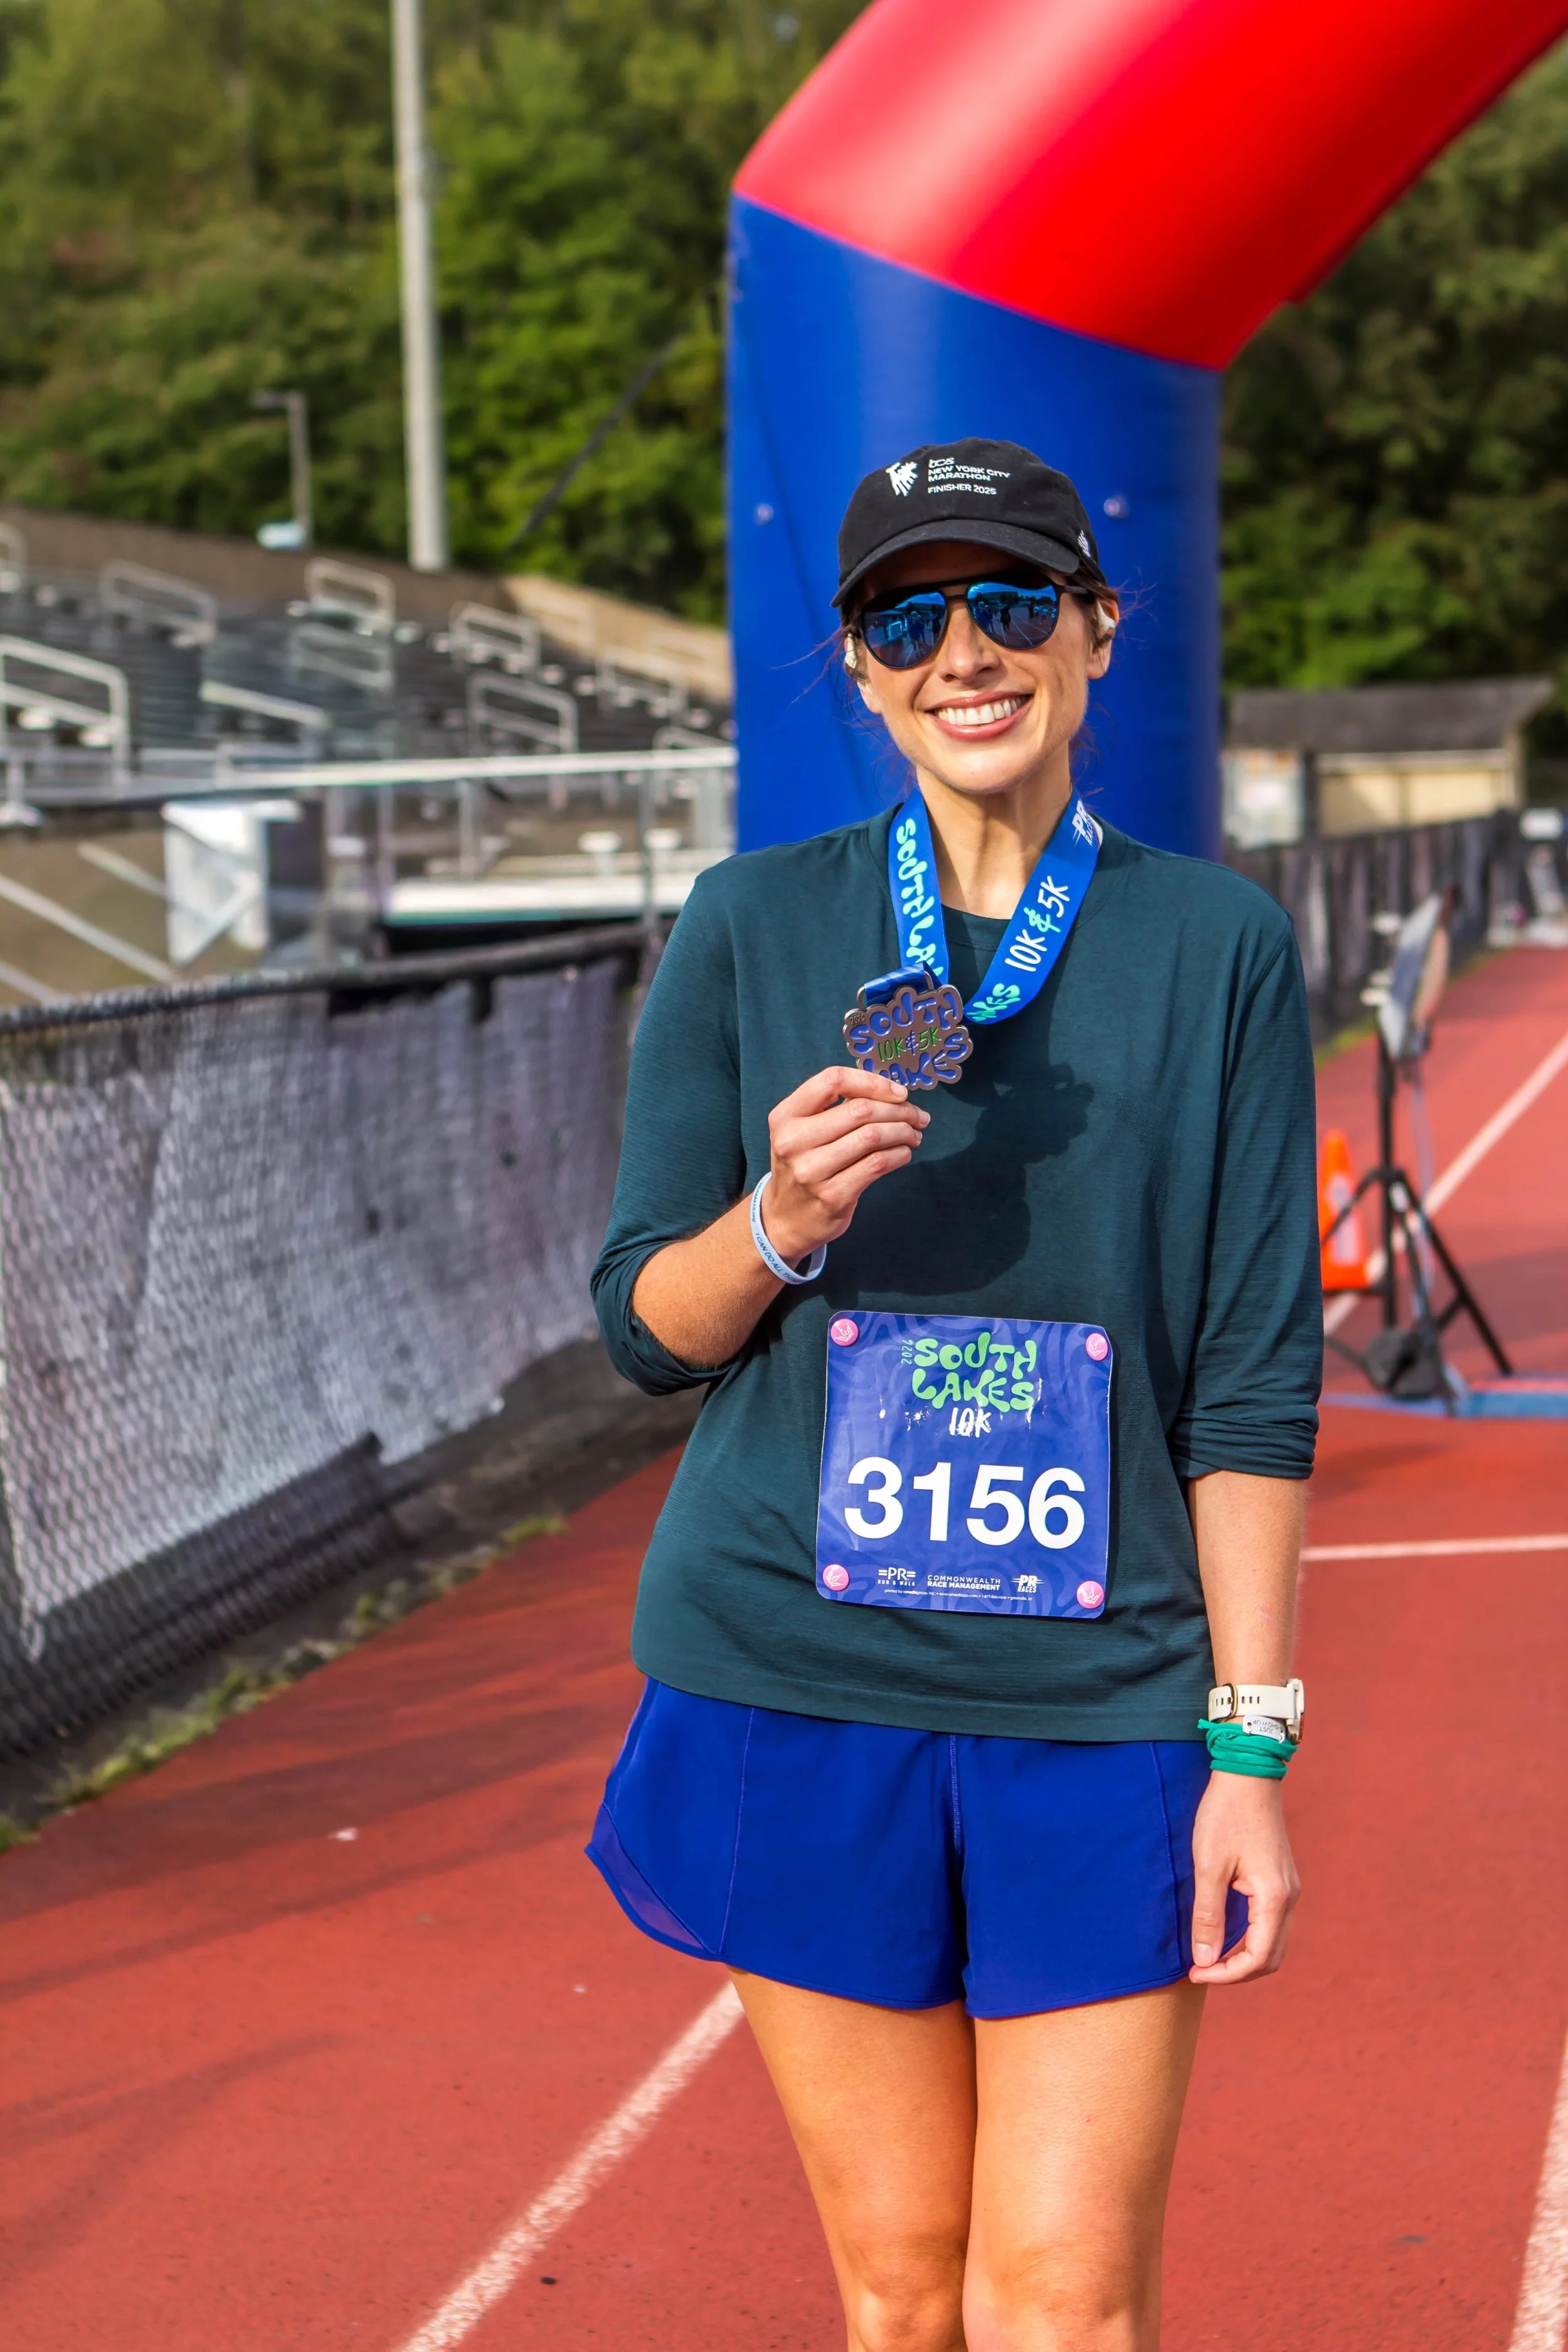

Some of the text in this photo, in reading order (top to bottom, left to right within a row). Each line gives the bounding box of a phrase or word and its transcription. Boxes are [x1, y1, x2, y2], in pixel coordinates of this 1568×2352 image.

[928, 465, 1011, 478] NEW YORK CITY
[928, 472, 991, 482] MARATHON
[928, 484, 998, 495] FINISHER 2025
[896, 818, 935, 918] SOUTH
[1037, 876, 1071, 918] 5K
[1024, 907, 1061, 933] &
[1005, 929, 1048, 972] 10K
[849, 991, 958, 1055] SOUTH
[756, 1236, 768, 1252] CAN
[765, 1252, 775, 1263] DO
[771, 1262, 783, 1273] ALL
[901, 1338, 914, 1365] 2026
[913, 1332, 1037, 1380] SOUTH
[912, 1368, 1035, 1413] LAKES
[949, 1407, 992, 1438] 10K
[844, 1456, 1086, 1550] 3156
[927, 1574, 1001, 1584] COMMONWEALTH
[948, 1582, 1001, 1591] MANAGEMENT
[1017, 1585, 1037, 1593] RACES
[1018, 1574, 1038, 1587] PR
